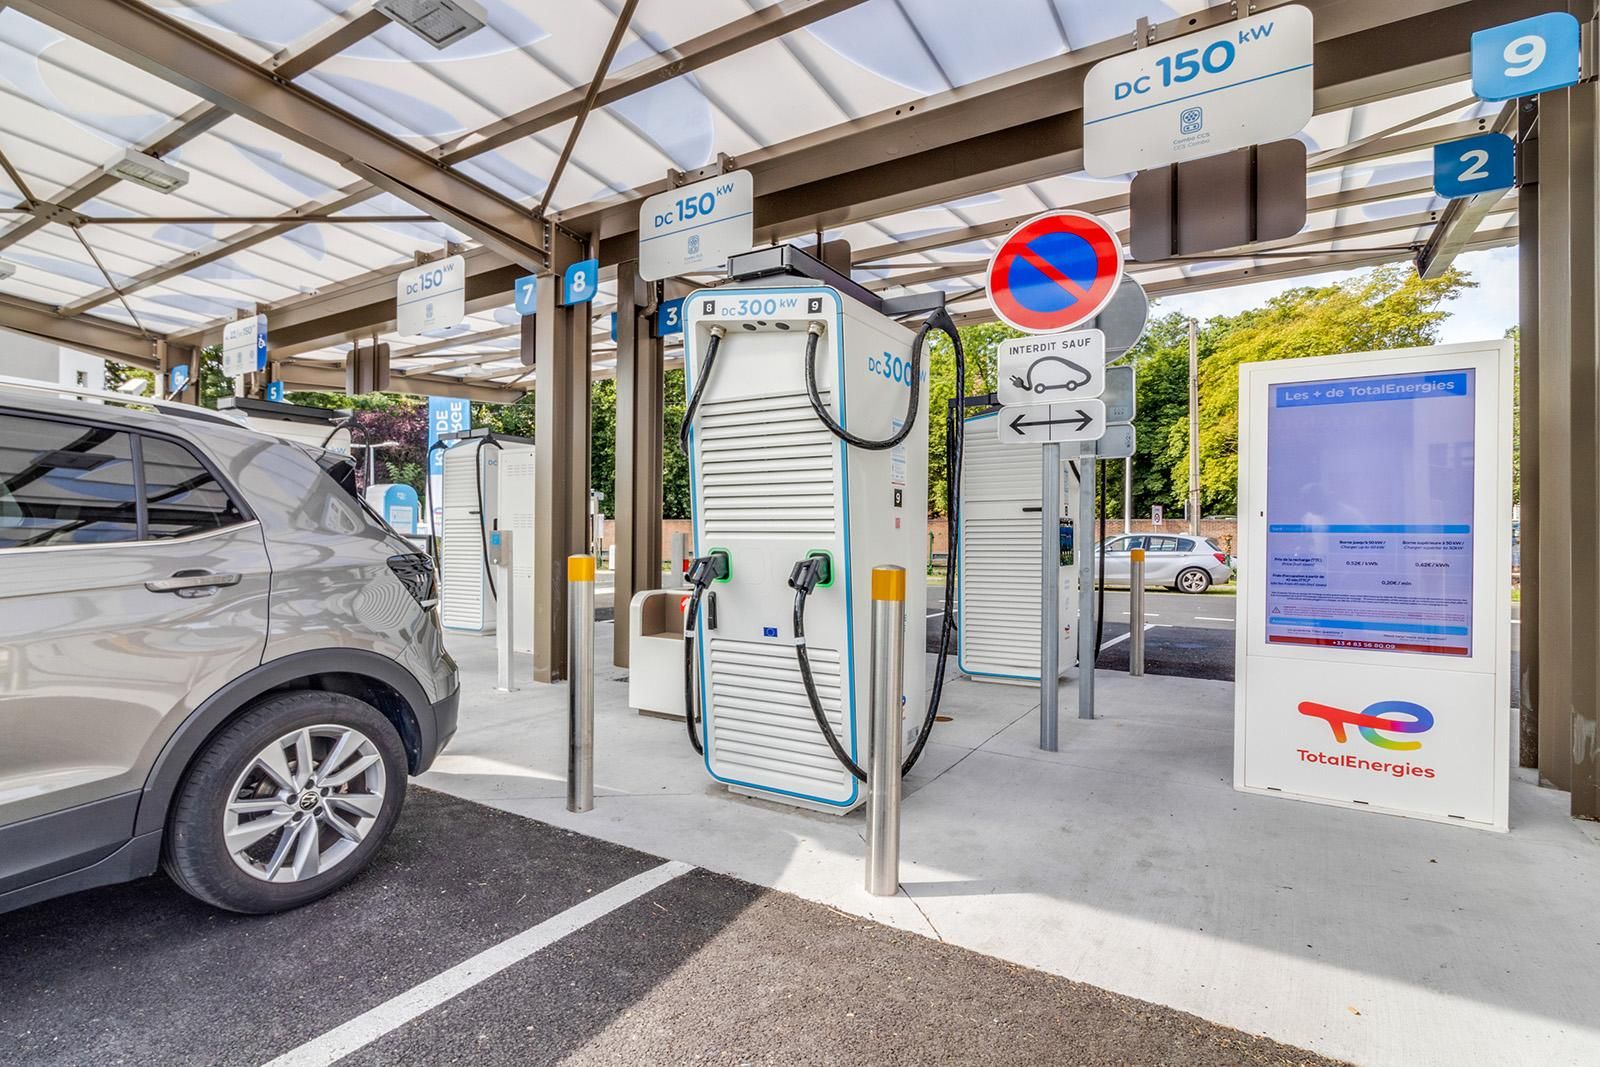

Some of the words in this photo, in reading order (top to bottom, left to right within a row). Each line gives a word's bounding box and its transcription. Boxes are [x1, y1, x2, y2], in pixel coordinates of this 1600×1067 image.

[1114, 76, 1151, 100] DC
[1156, 40, 1236, 87] 150
[1238, 22, 1274, 44] kW
[1503, 35, 1546, 77] 9
[1457, 149, 1489, 182] 2
[654, 212, 673, 228] DC
[676, 192, 716, 222] 150
[716, 182, 734, 196] kW
[406, 283, 418, 295] DC
[419, 268, 443, 291] 150
[443, 263, 454, 273] kW
[573, 270, 586, 293] 8
[522, 283, 534, 305] 7
[666, 306, 678, 326] 3
[706, 303, 713, 312] 8
[721, 307, 736, 316] DC
[738, 299, 777, 316] 300
[779, 298, 798, 308] kW
[811, 301, 819, 311] 9
[1009, 342, 1057, 355] INTERDIT
[1062, 337, 1091, 349] SAUF
[868, 356, 882, 375] DC
[883, 351, 912, 387] 300
[270, 386, 277, 400] 5
[1285, 390, 1309, 401] Les
[1313, 391, 1321, 399] +
[1325, 387, 1344, 398] de
[1349, 380, 1455, 397] TotalEnergies
[896, 492, 901, 504] 9
[1296, 749, 1436, 779] TotalEnergies
